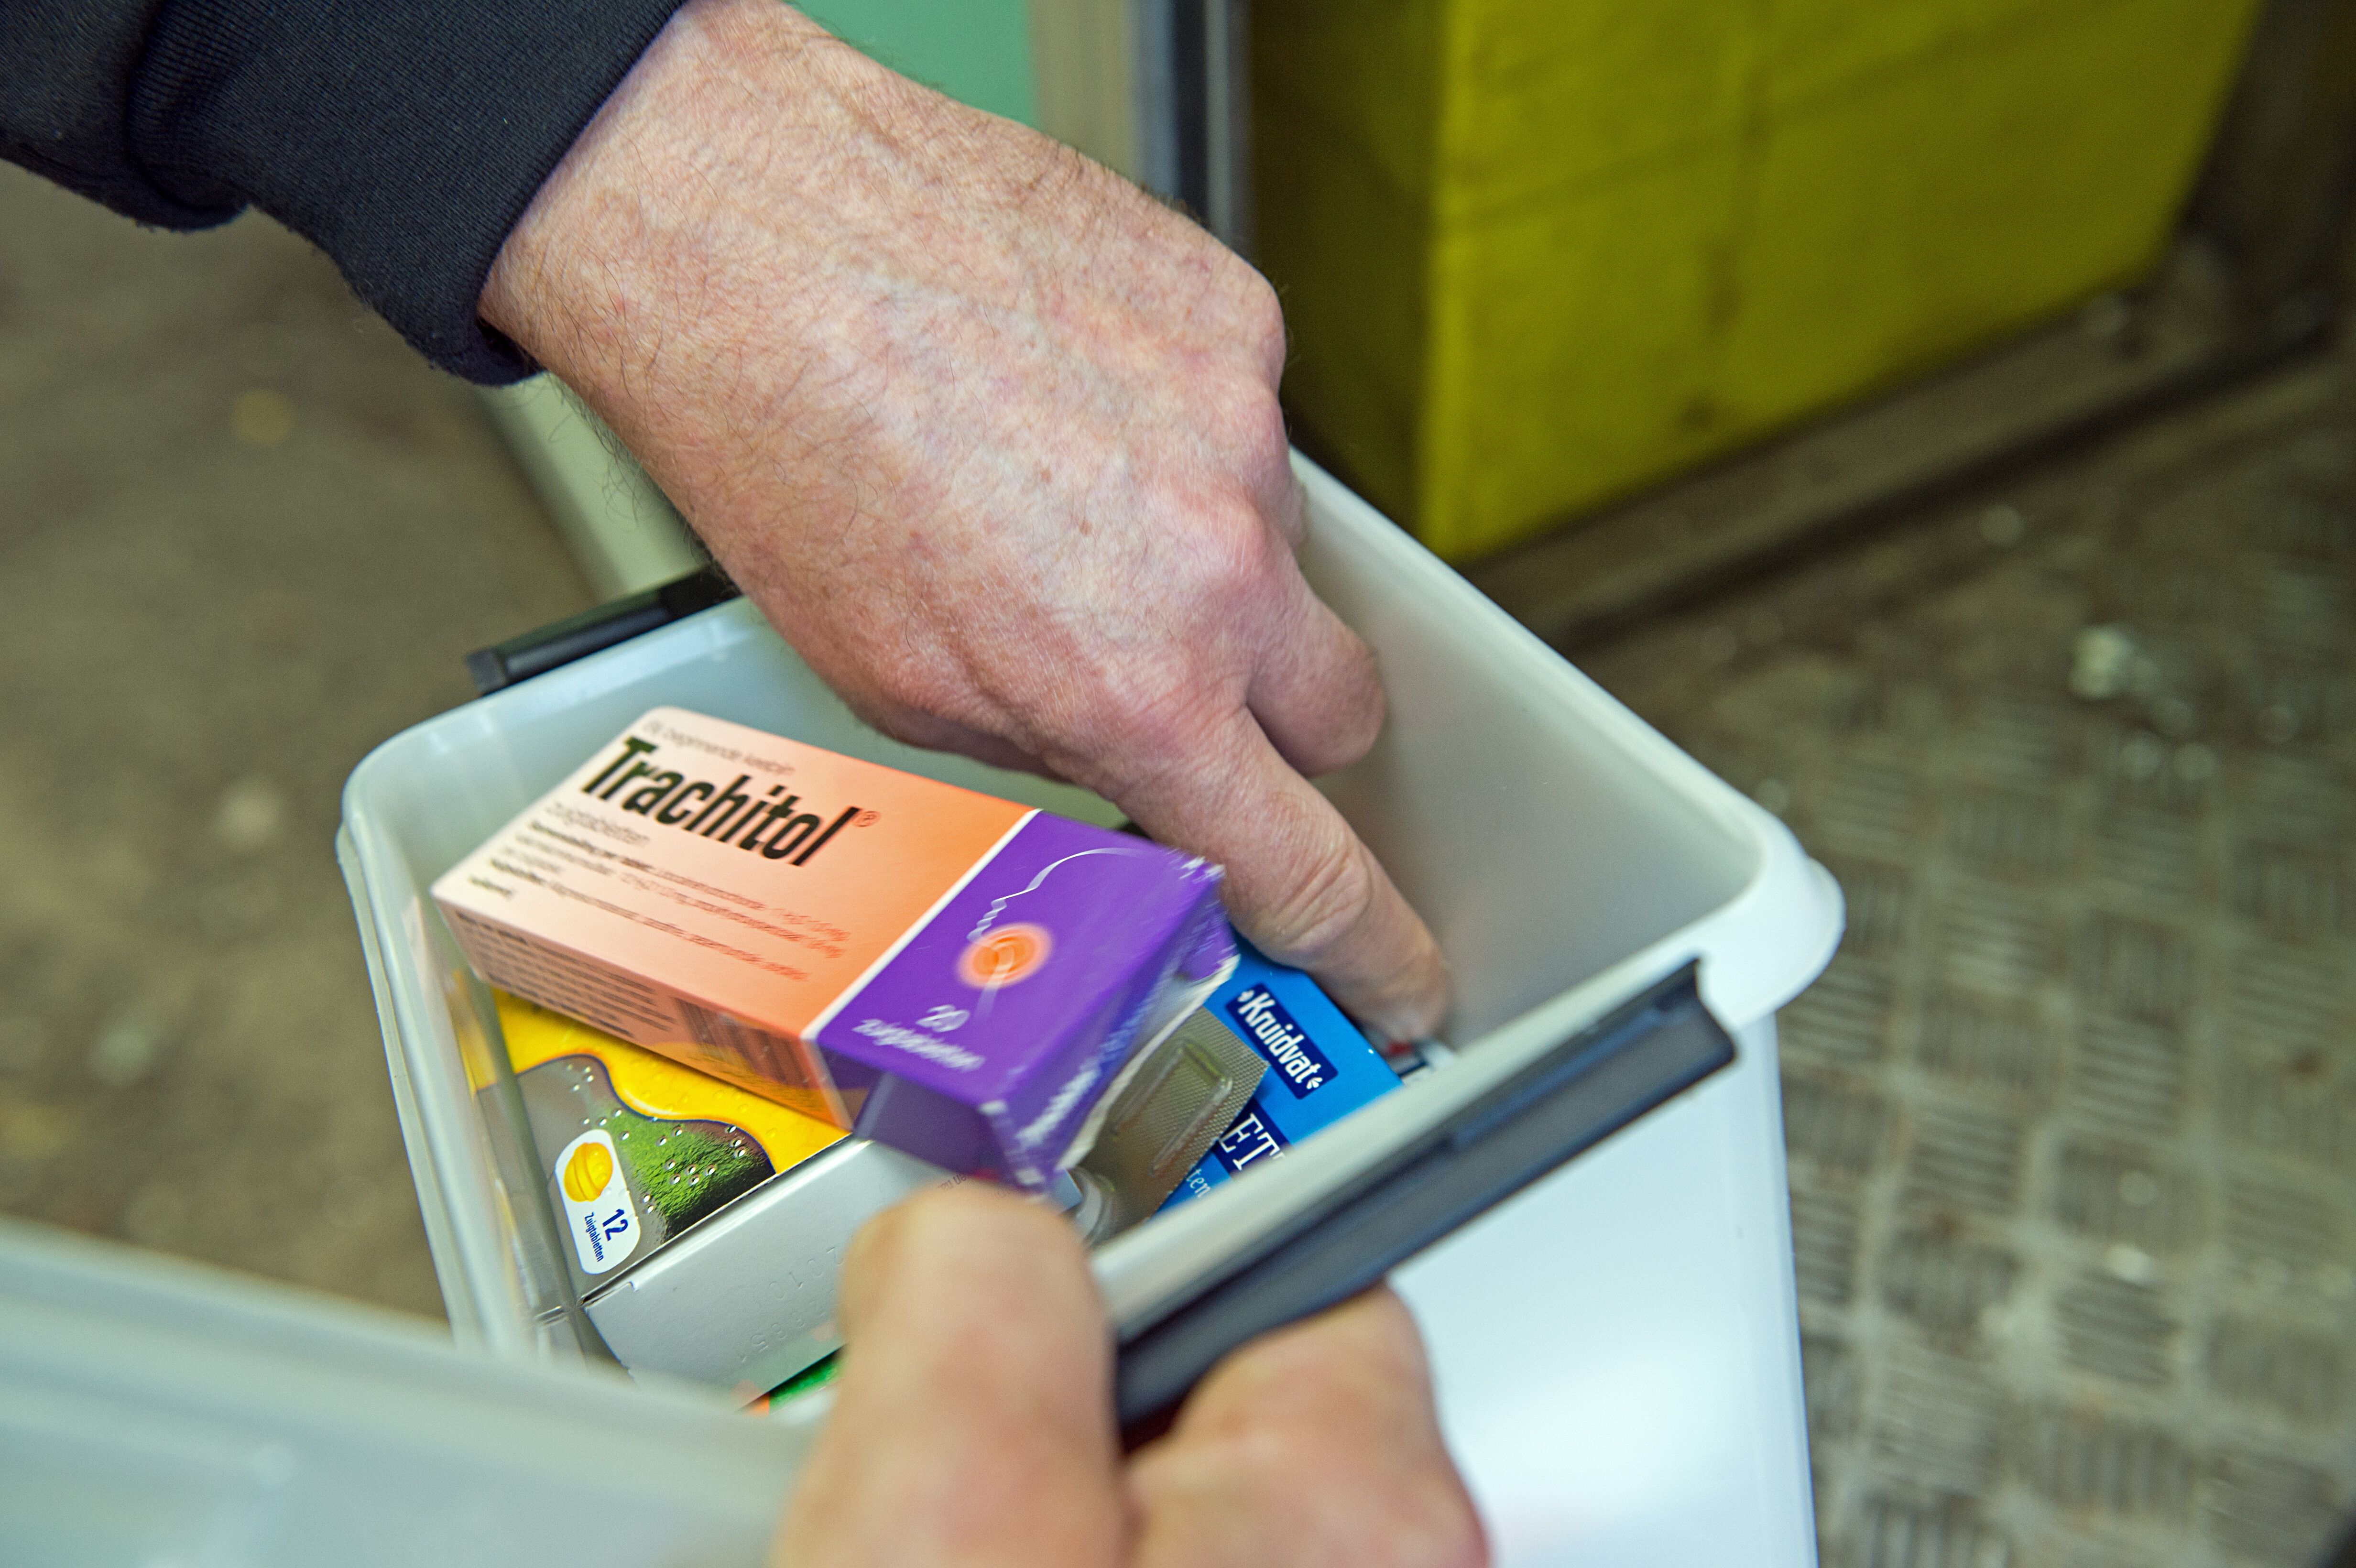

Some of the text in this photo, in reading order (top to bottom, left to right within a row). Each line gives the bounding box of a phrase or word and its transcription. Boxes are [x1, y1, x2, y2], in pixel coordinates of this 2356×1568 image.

[1237, 992, 1321, 1084] Kruidvat
[584, 1211, 604, 1263] Zuigtabletten
[602, 1208, 629, 1242] 12
